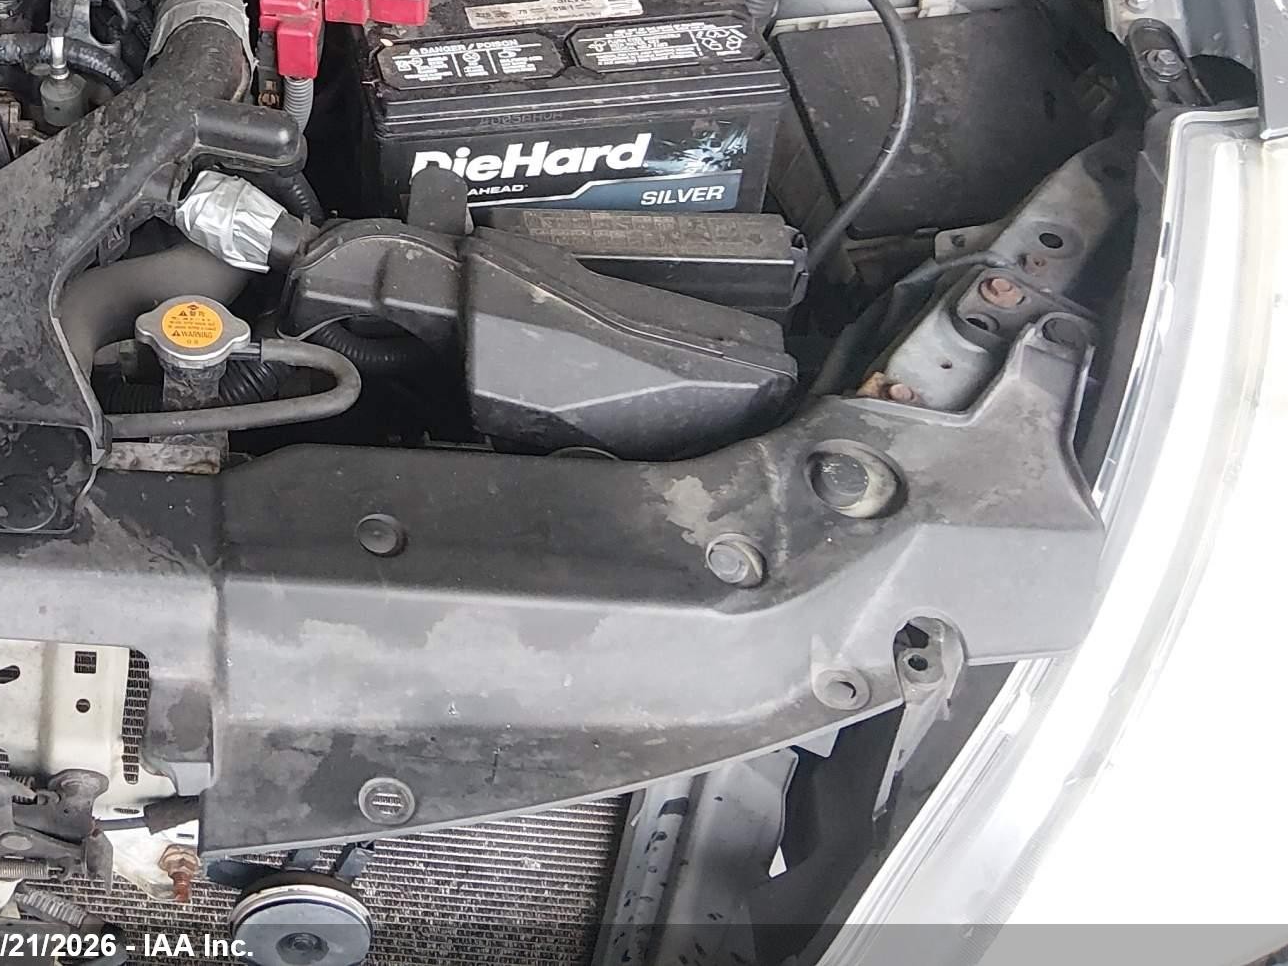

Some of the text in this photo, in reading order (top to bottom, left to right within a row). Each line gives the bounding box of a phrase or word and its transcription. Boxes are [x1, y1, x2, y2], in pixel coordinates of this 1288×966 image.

[420, 44, 466, 55] DANGER
[477, 39, 519, 50] POISON
[467, 184, 524, 196] AHEAD
[640, 185, 725, 206] SILVER
[181, 330, 213, 339] WARNING
